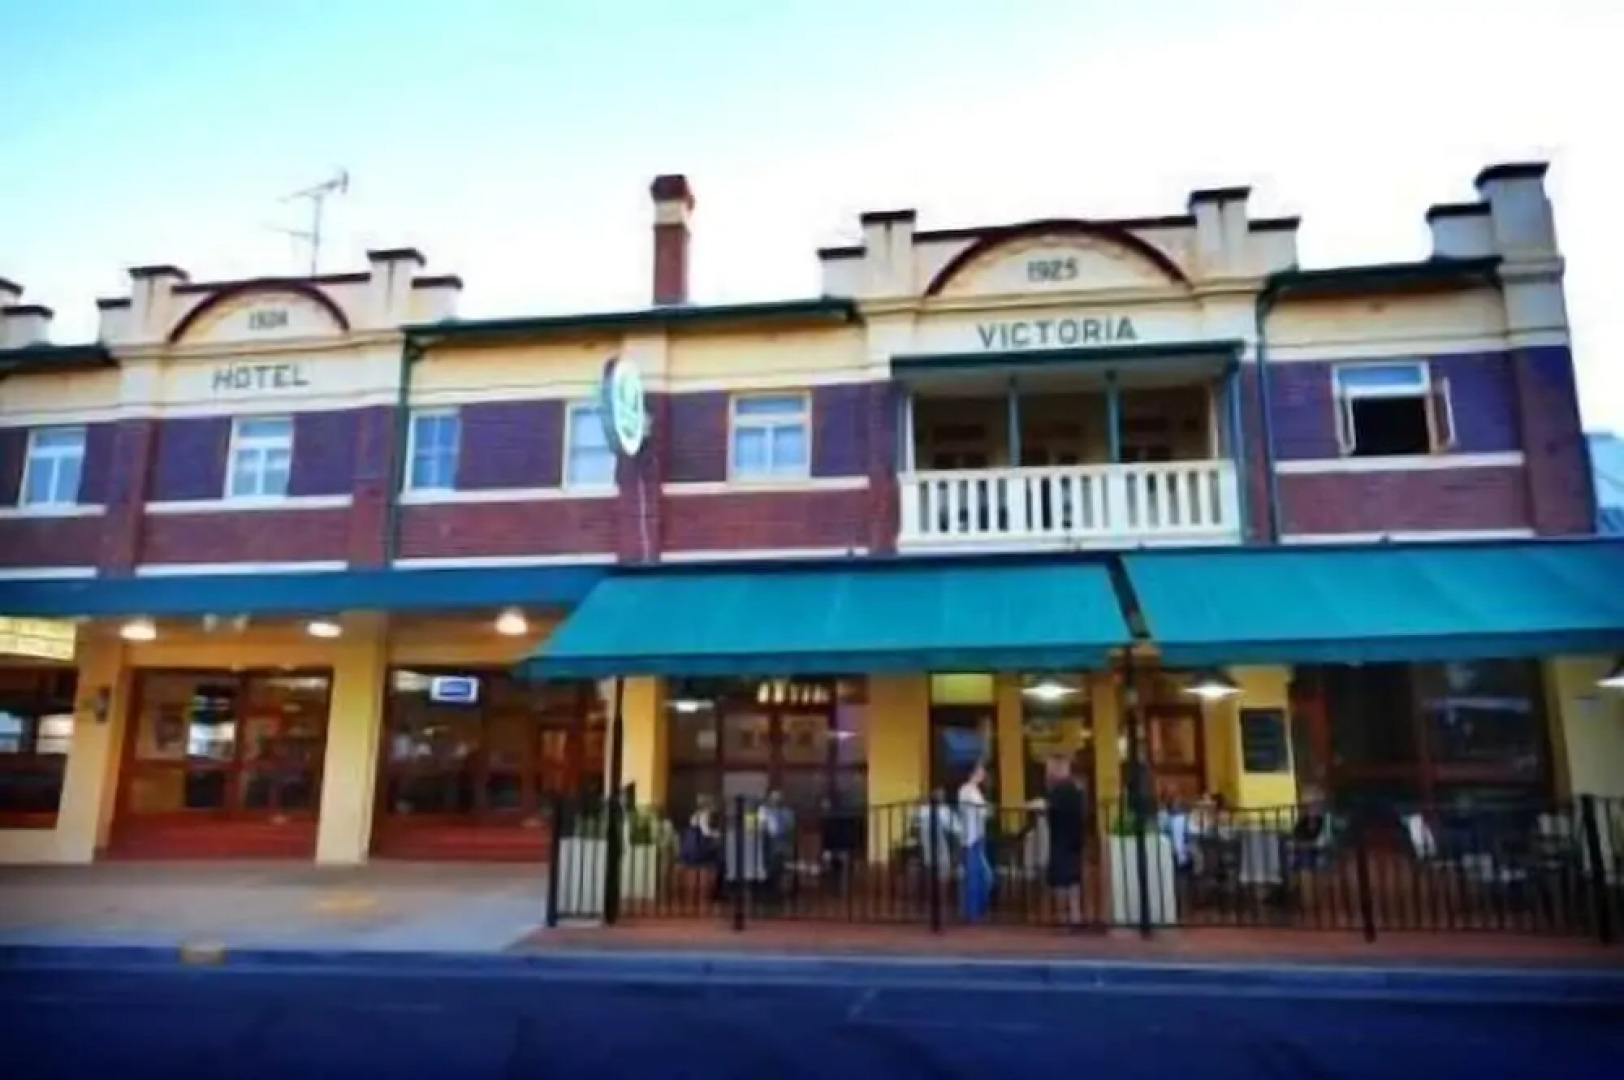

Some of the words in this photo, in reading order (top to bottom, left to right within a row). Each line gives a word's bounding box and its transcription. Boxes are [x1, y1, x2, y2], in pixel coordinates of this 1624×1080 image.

[1027, 257, 1078, 281] 1925
[977, 316, 1137, 349] VICTORIA
[212, 363, 310, 390] HOTEL
